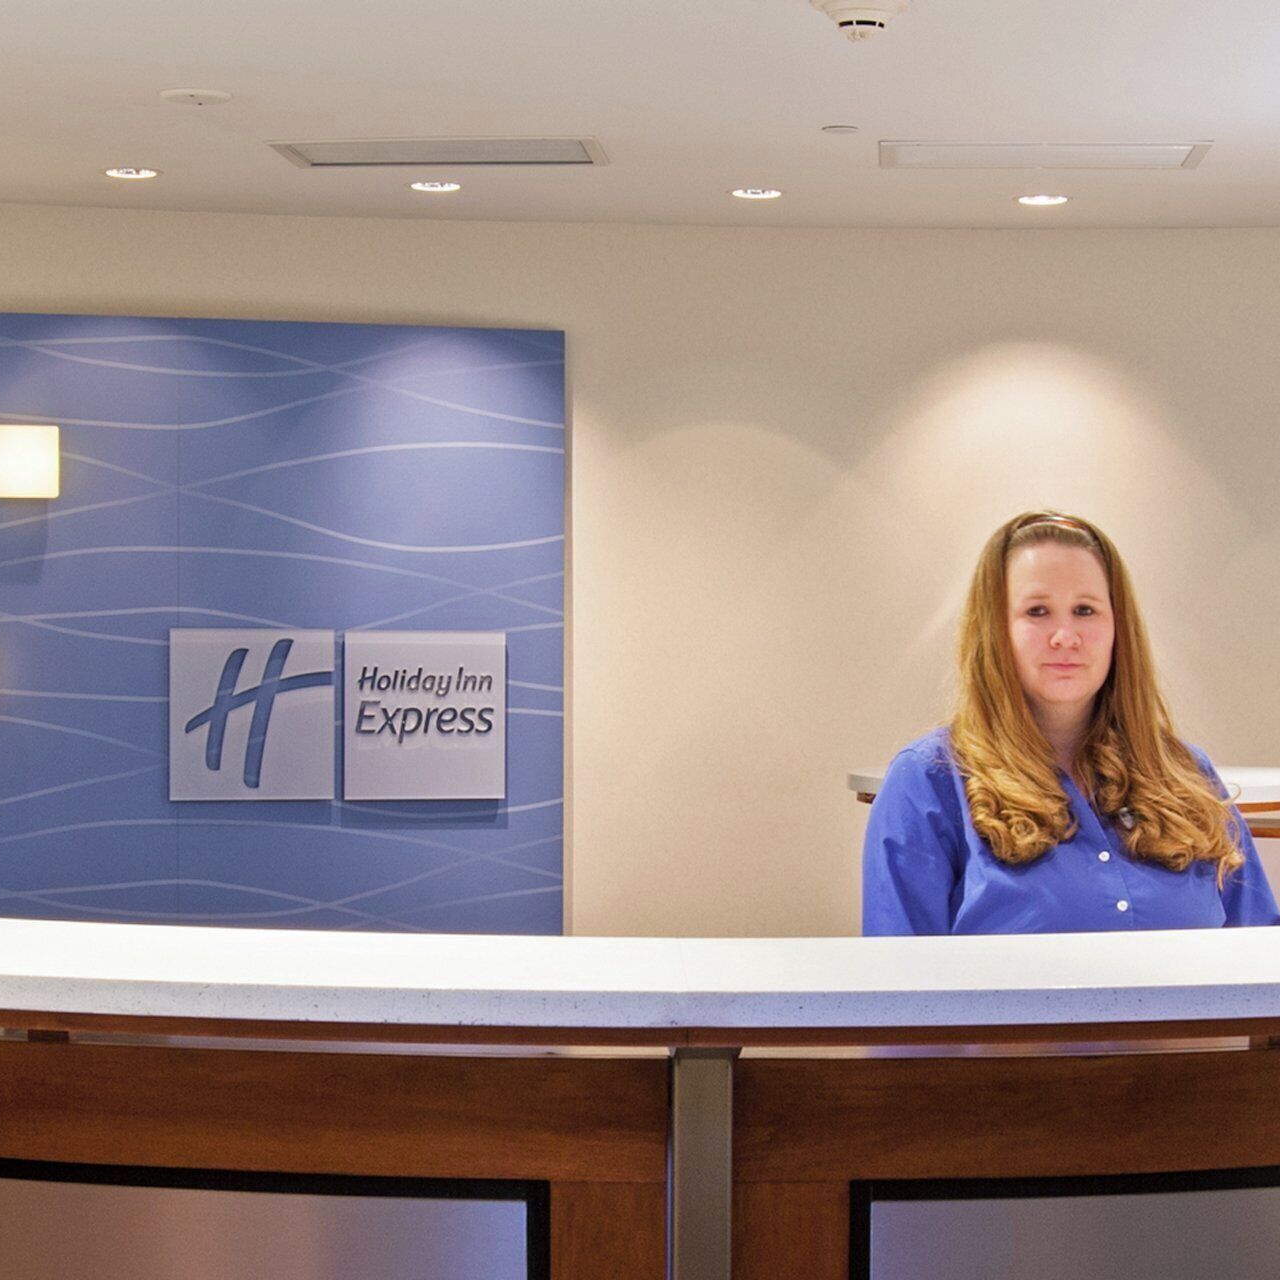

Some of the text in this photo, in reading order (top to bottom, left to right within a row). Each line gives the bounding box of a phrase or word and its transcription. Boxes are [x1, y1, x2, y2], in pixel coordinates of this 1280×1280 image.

[358, 666, 494, 697] Holiday Inn
[355, 699, 495, 745] Express
